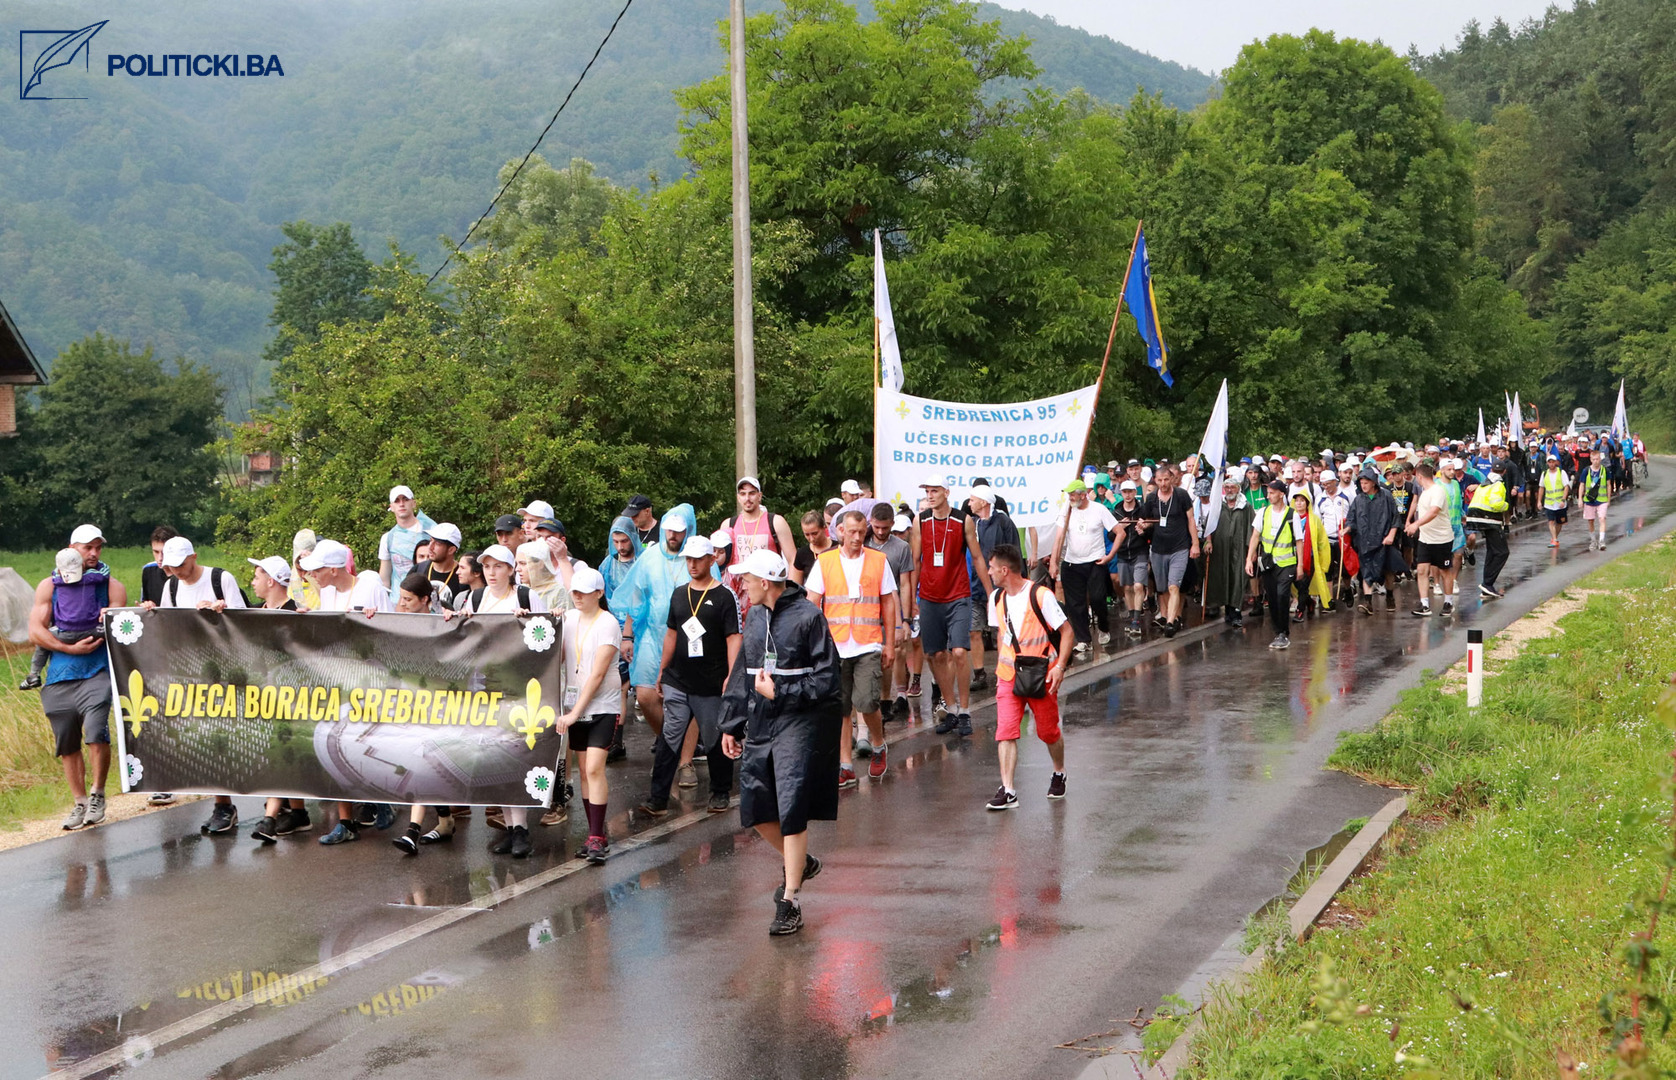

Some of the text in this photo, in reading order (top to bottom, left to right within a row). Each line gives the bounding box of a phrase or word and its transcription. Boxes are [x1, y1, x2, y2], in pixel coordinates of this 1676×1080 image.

[922, 403, 1057, 422] SREBRENICA 95
[904, 430, 1068, 448] UČESNICI PROBOJA
[893, 449, 1074, 467] BRDSKOG BATALJONA
[1005, 497, 1050, 516] OLIĆ
[164, 683, 503, 726] DJECA BORACA SREBRENICE
